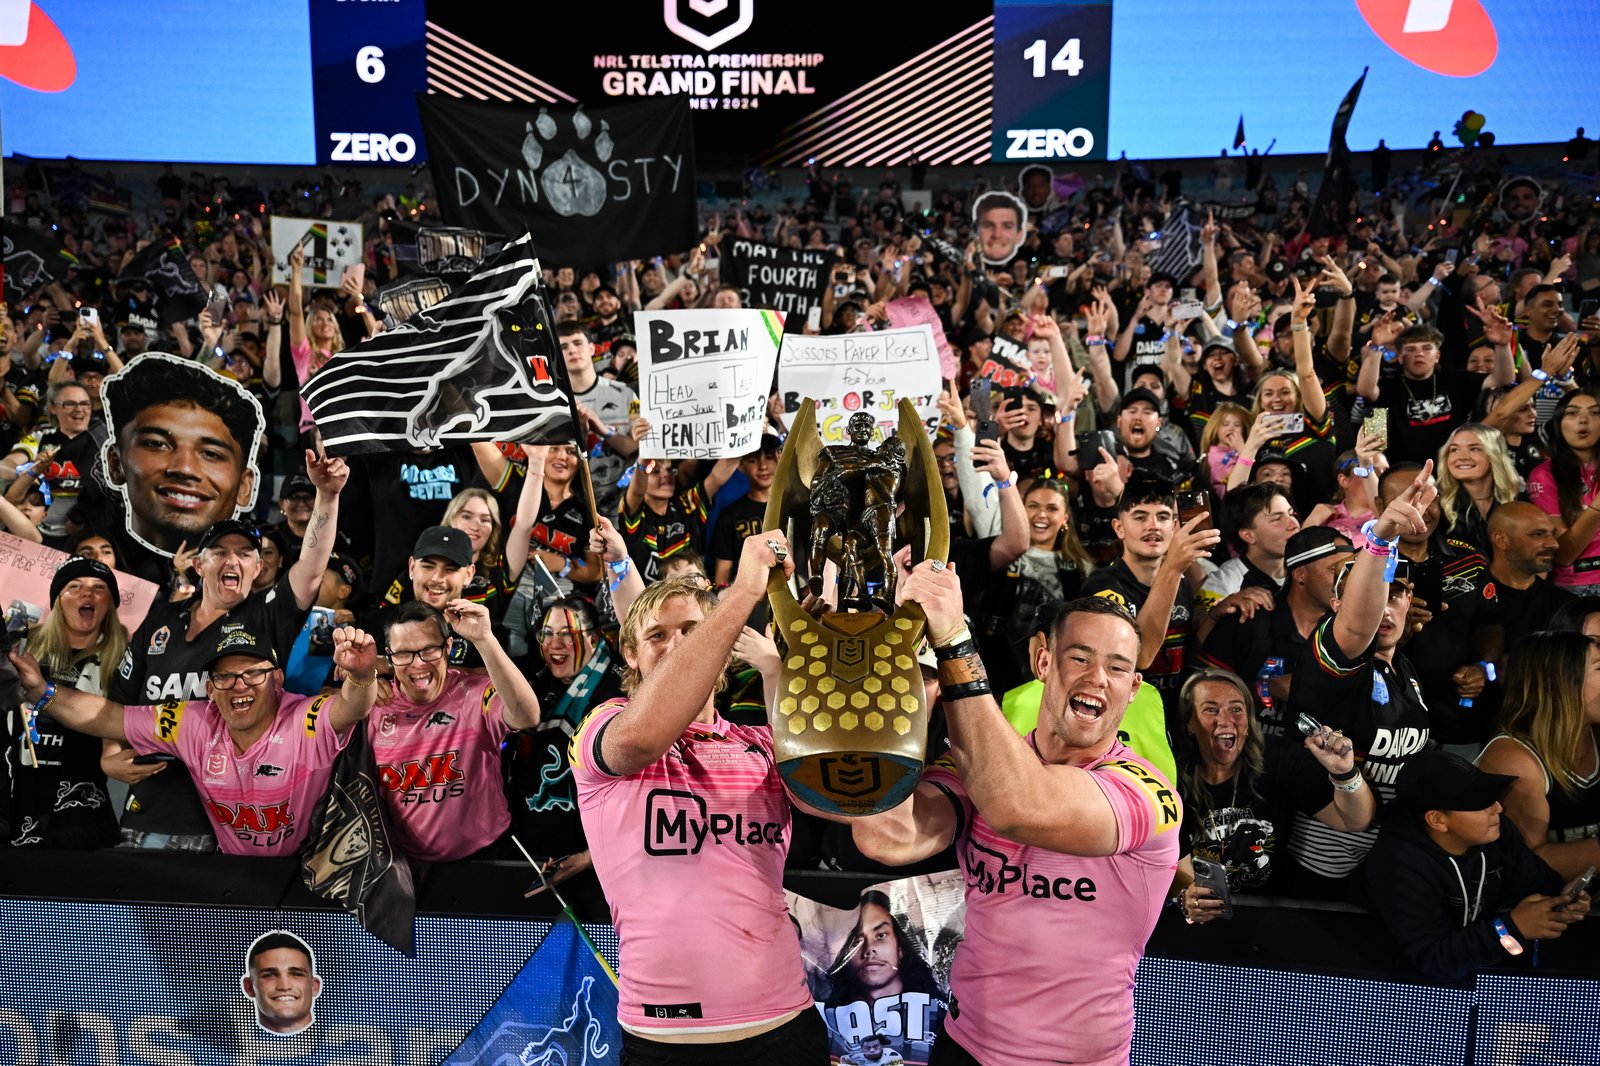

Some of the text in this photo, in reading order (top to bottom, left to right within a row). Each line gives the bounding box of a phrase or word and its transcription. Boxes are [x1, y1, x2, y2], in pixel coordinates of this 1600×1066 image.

[355, 46, 386, 83] 6
[594, 53, 824, 69] NRL TELSTRA PREMIERSHIP
[1023, 38, 1084, 78] 14
[602, 70, 815, 96] GRAND FINAL
[689, 98, 758, 109] NEY 2024
[330, 132, 416, 162] ZERO
[1006, 127, 1094, 159] ZERO
[732, 241, 778, 259] MAY
[748, 264, 818, 290] FOURTH
[648, 319, 749, 365] BRIAN
[784, 336, 920, 363] SCISSORS PAPER ROCK
[843, 390, 875, 412] OR
[665, 448, 722, 459] PRIDE
[400, 783, 465, 807] PLUS
[655, 807, 785, 855] MyPlace
